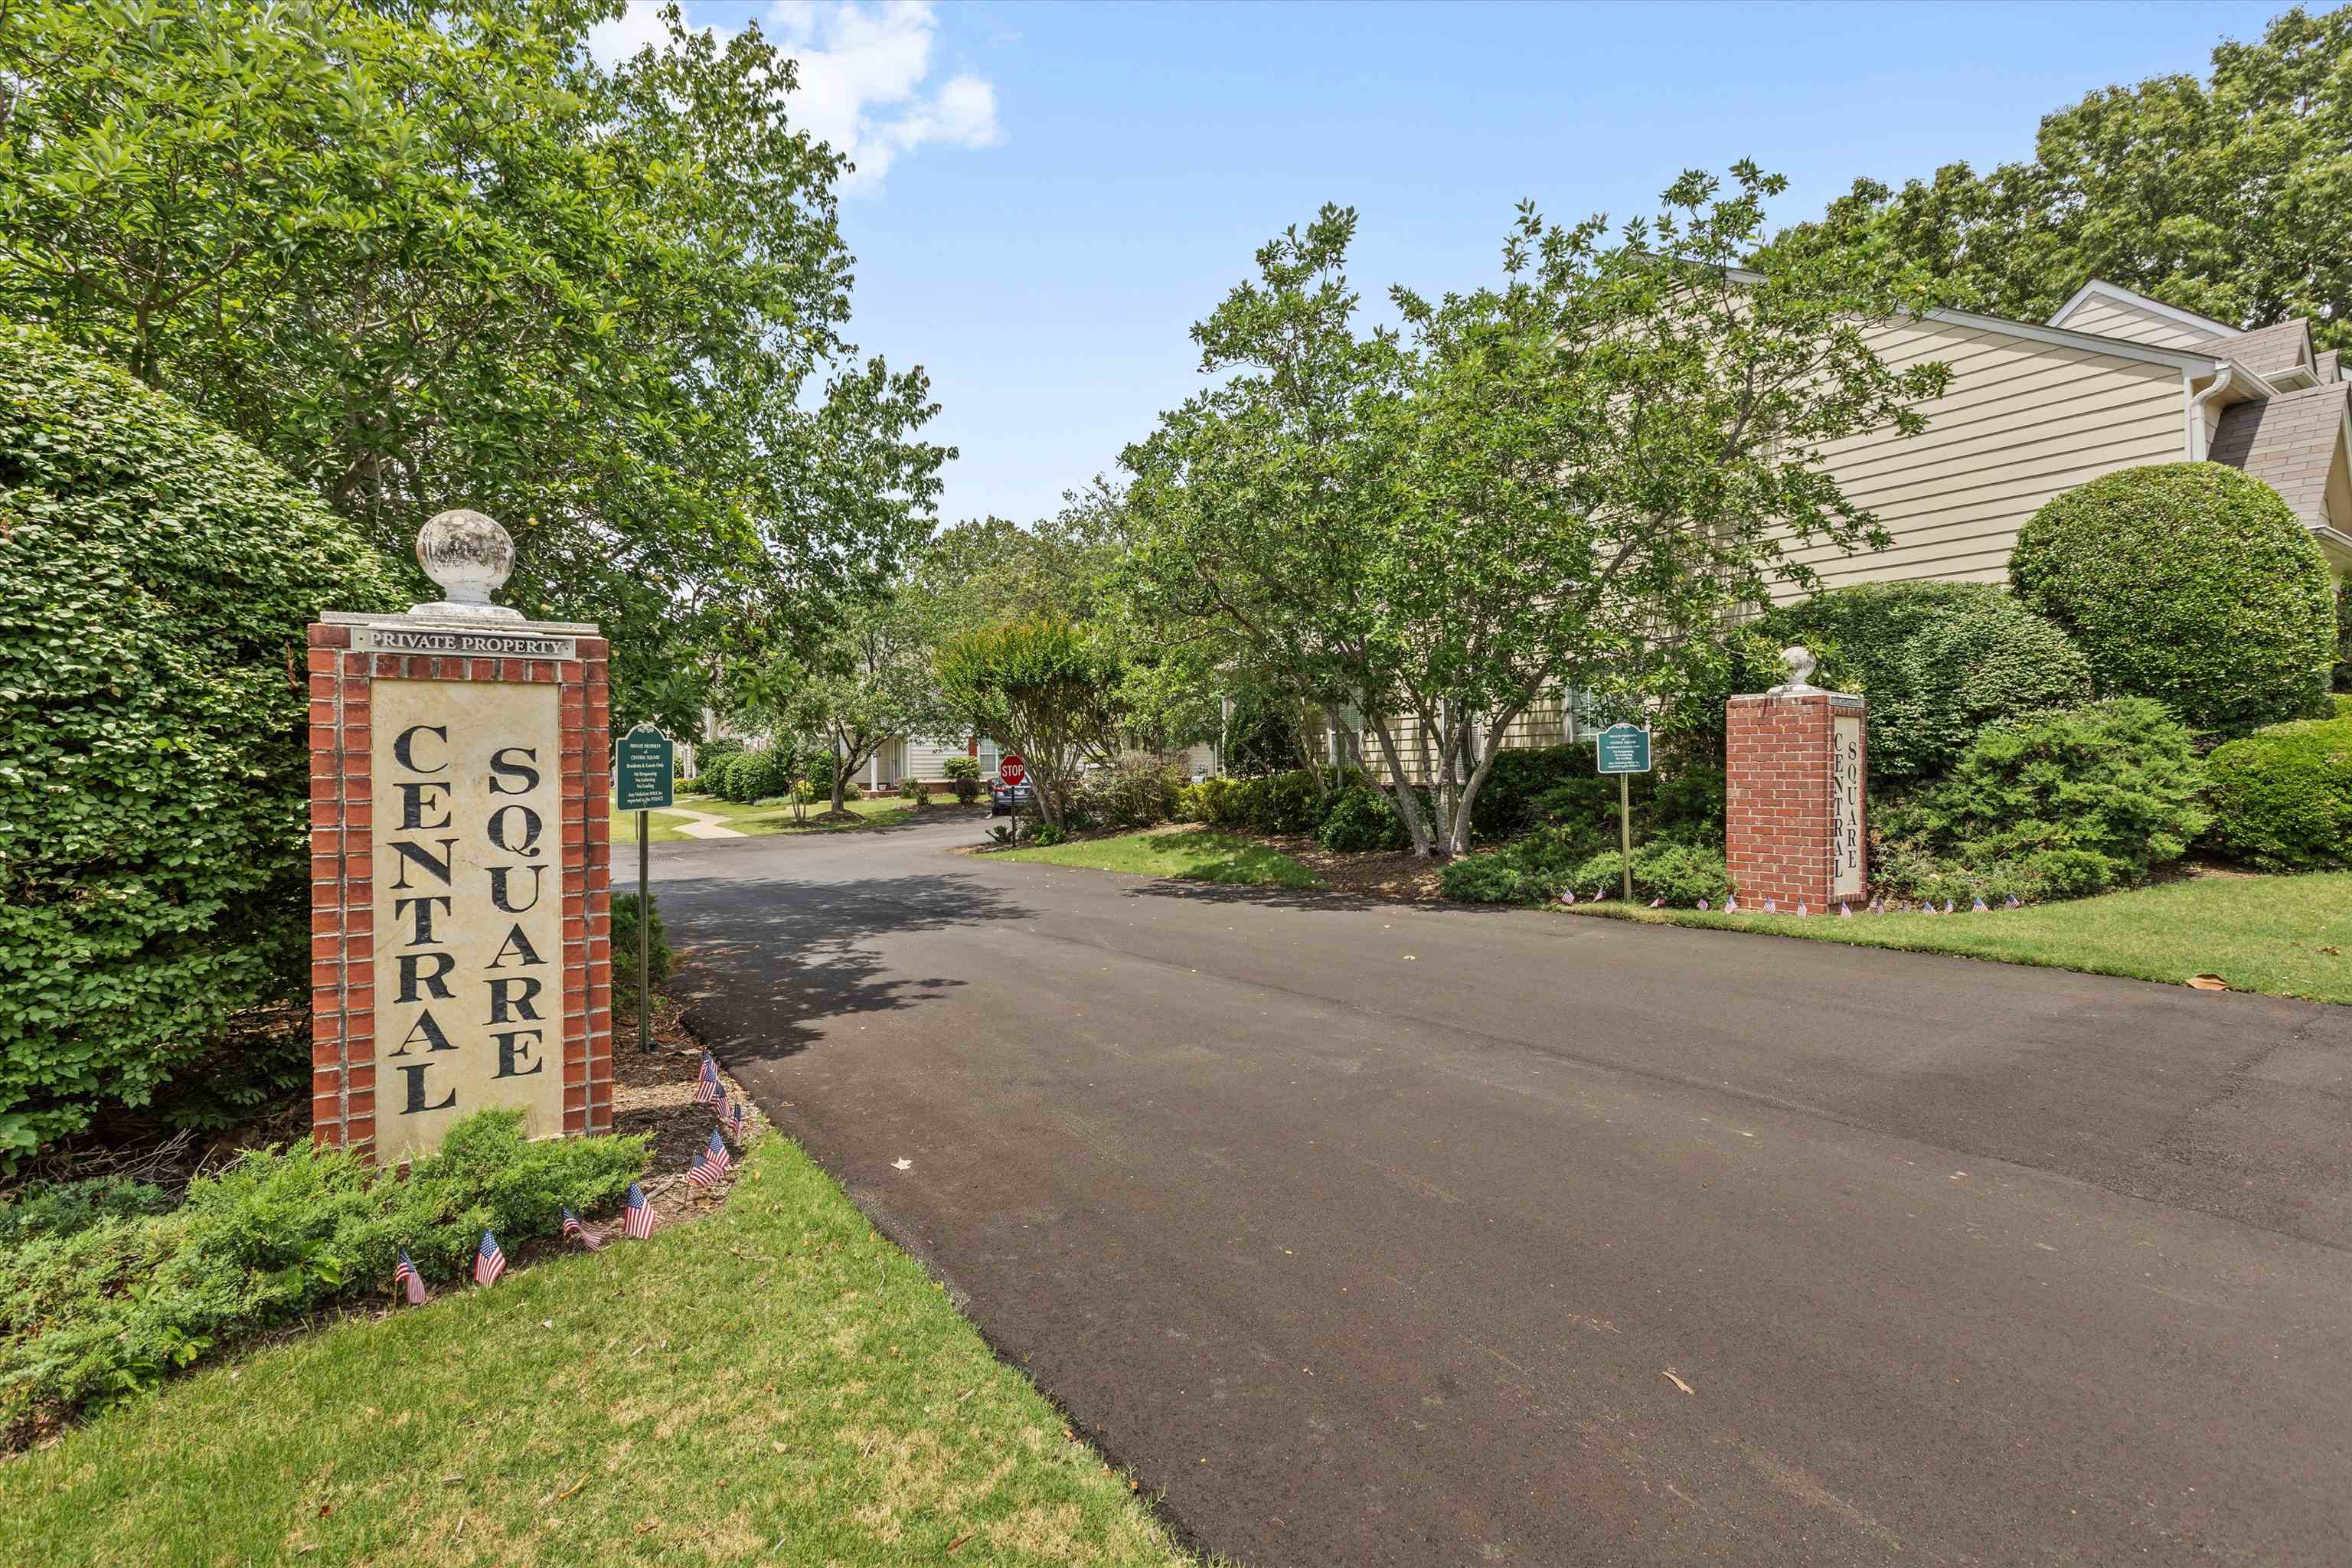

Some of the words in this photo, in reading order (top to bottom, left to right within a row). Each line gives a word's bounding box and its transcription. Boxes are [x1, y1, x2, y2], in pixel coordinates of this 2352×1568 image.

[369, 632, 456, 650] PRIVATE
[461, 637, 564, 654] PROPERTY
[1002, 765, 1023, 777] STOP
[1834, 732, 1844, 878] CENTRAL
[1847, 741, 1857, 868] SQUARE
[387, 725, 459, 1116] CENTRAL
[482, 746, 549, 1080] SQUARE
